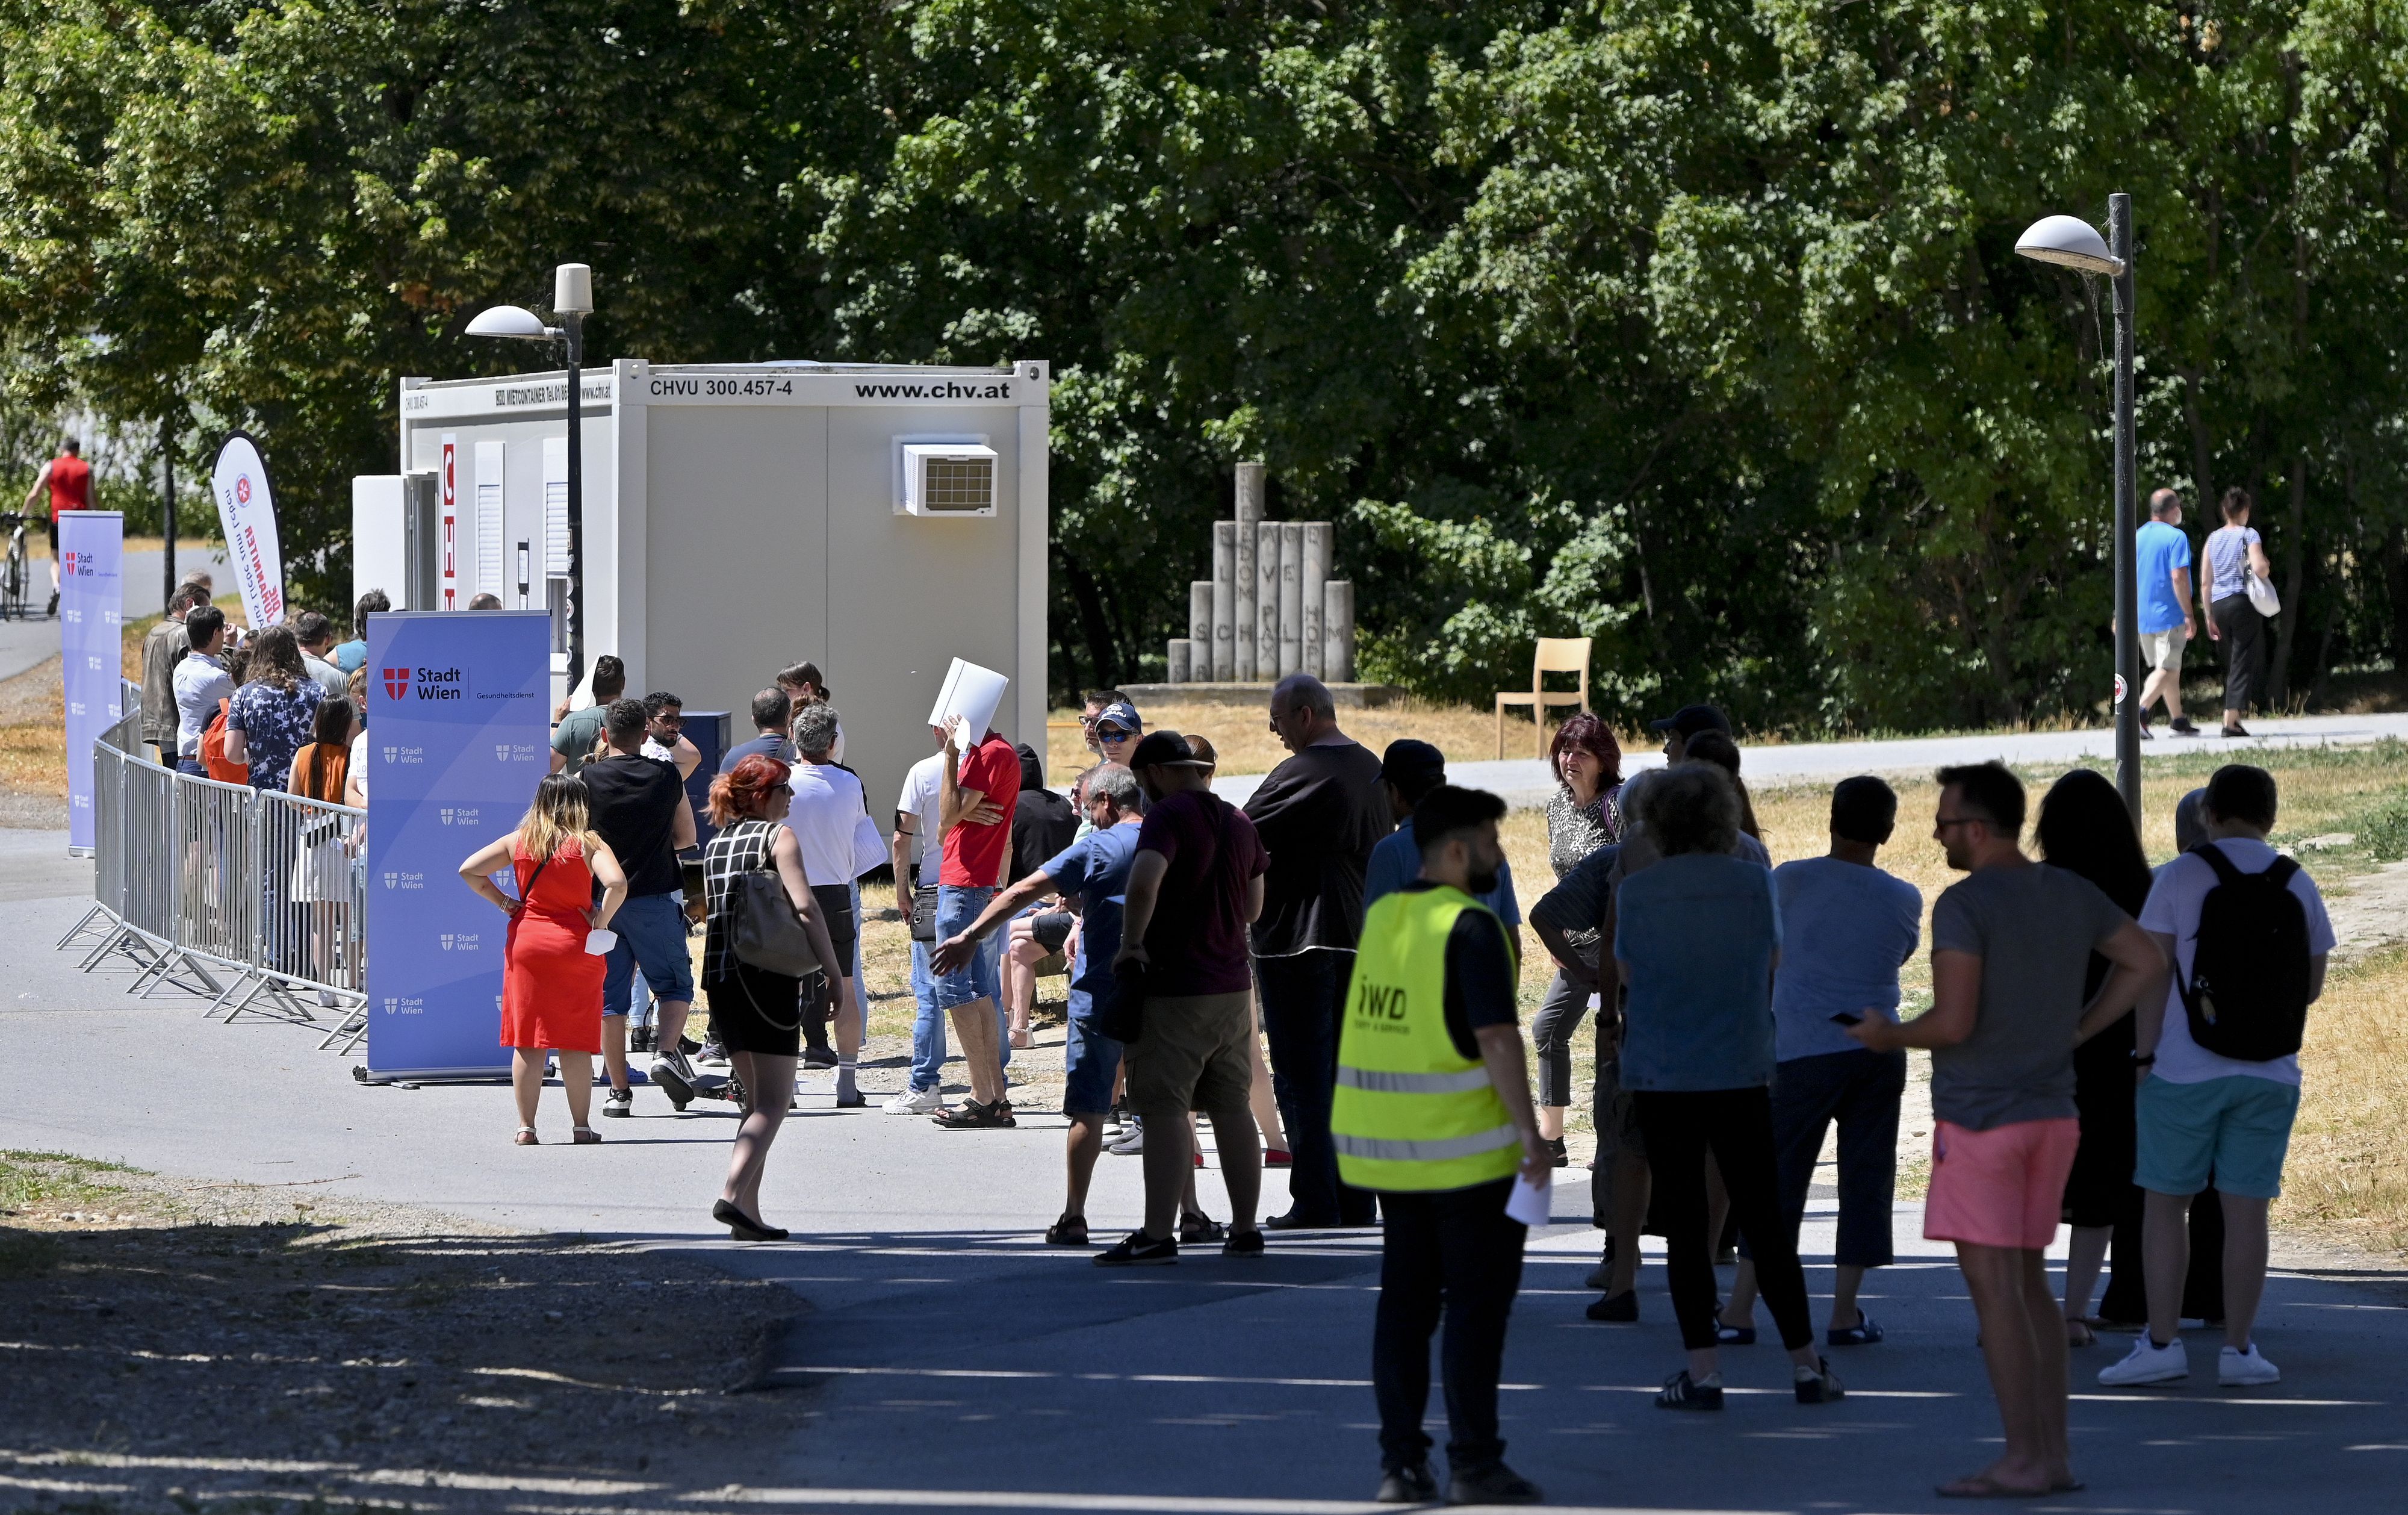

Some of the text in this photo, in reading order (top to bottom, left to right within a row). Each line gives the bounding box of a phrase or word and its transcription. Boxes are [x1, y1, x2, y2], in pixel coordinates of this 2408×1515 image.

[507, 387, 545, 405] MIETCONTAINER
[582, 382, 610, 399] www.chv.at
[650, 380, 793, 396] CHVU 300.457-4
[855, 382, 1010, 399] www.chv.at
[78, 552, 93, 563] Stadt
[78, 566, 93, 576] Wien
[417, 667, 461, 682] Stadt
[417, 685, 461, 700] Wien
[513, 744, 535, 753] Stadt
[401, 881, 423, 889] Wien
[457, 942, 479, 951] Wien
[401, 998, 423, 1006] Stadt
